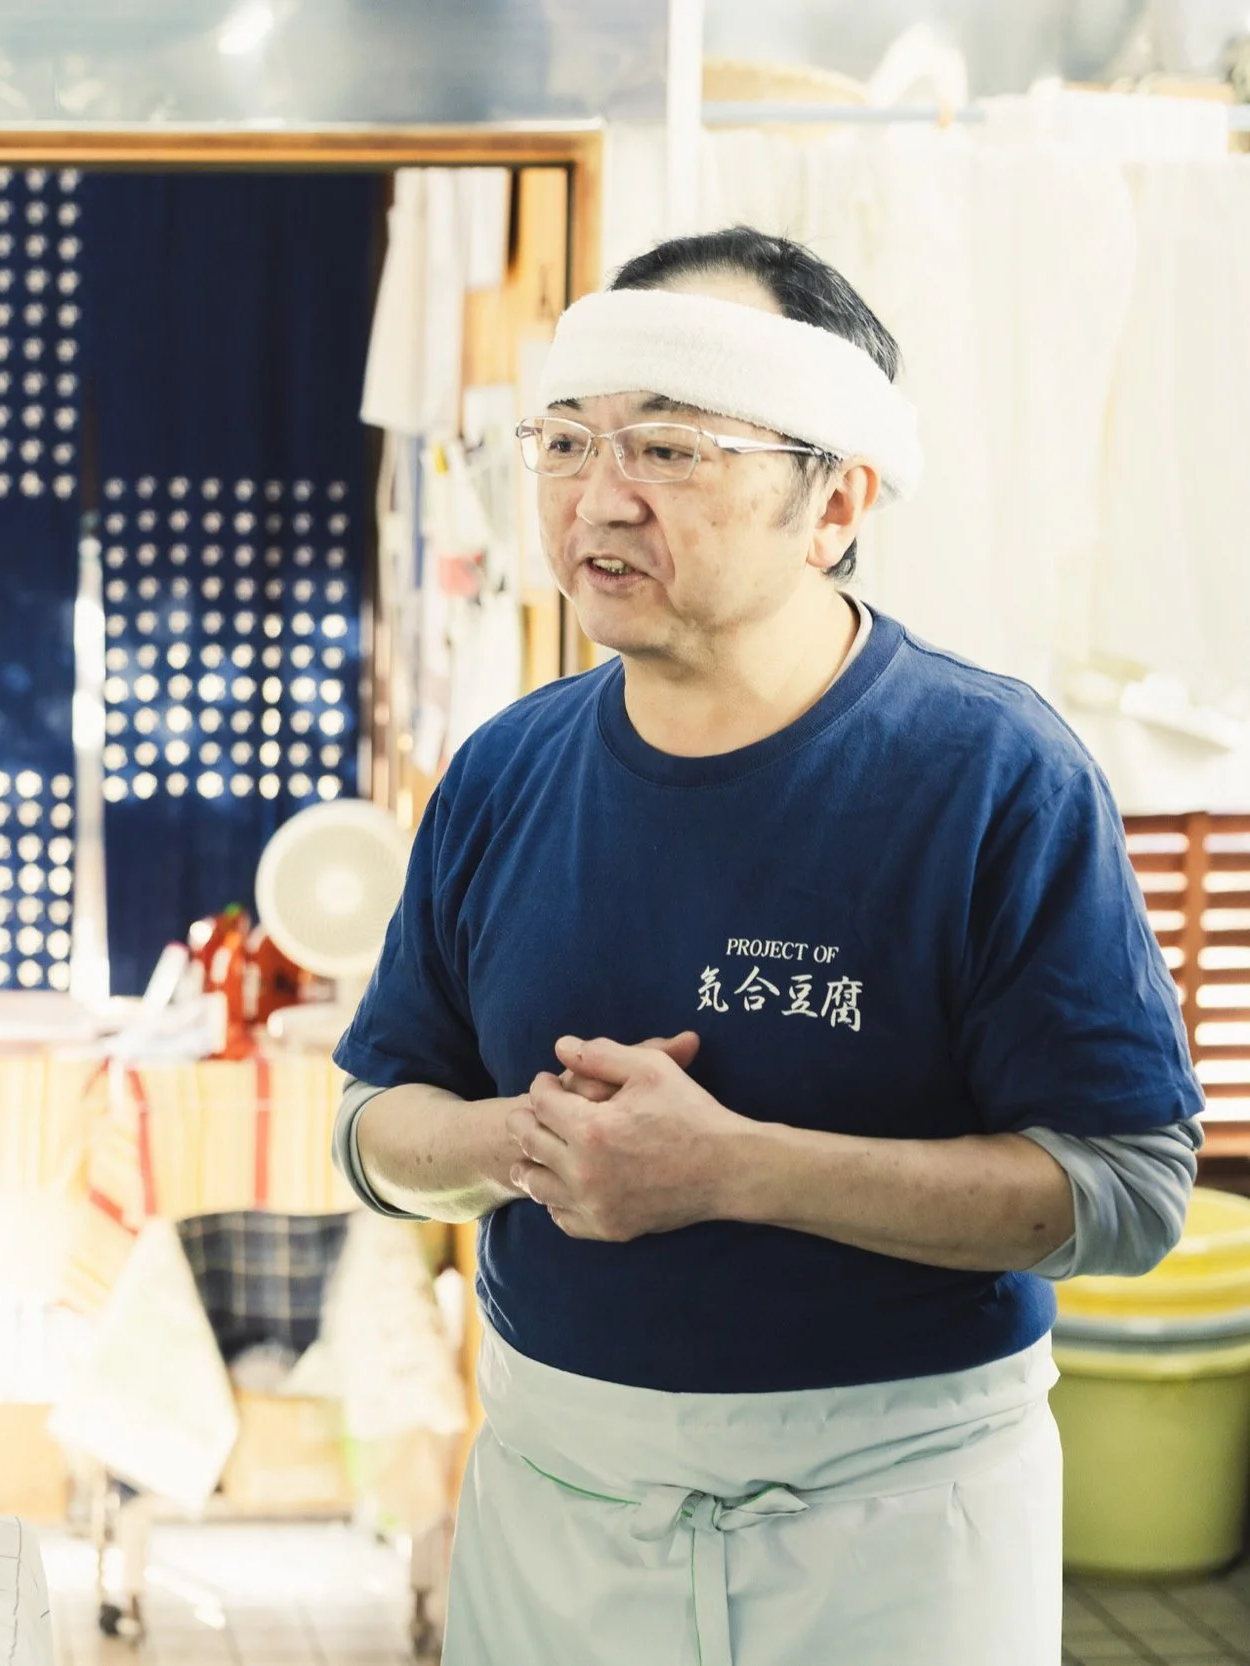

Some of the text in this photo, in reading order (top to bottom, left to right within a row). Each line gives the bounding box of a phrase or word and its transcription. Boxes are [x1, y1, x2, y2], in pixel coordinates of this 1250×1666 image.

[726, 938, 839, 964] PROJECT OF
[697, 965, 863, 1032] 気合豆腐
